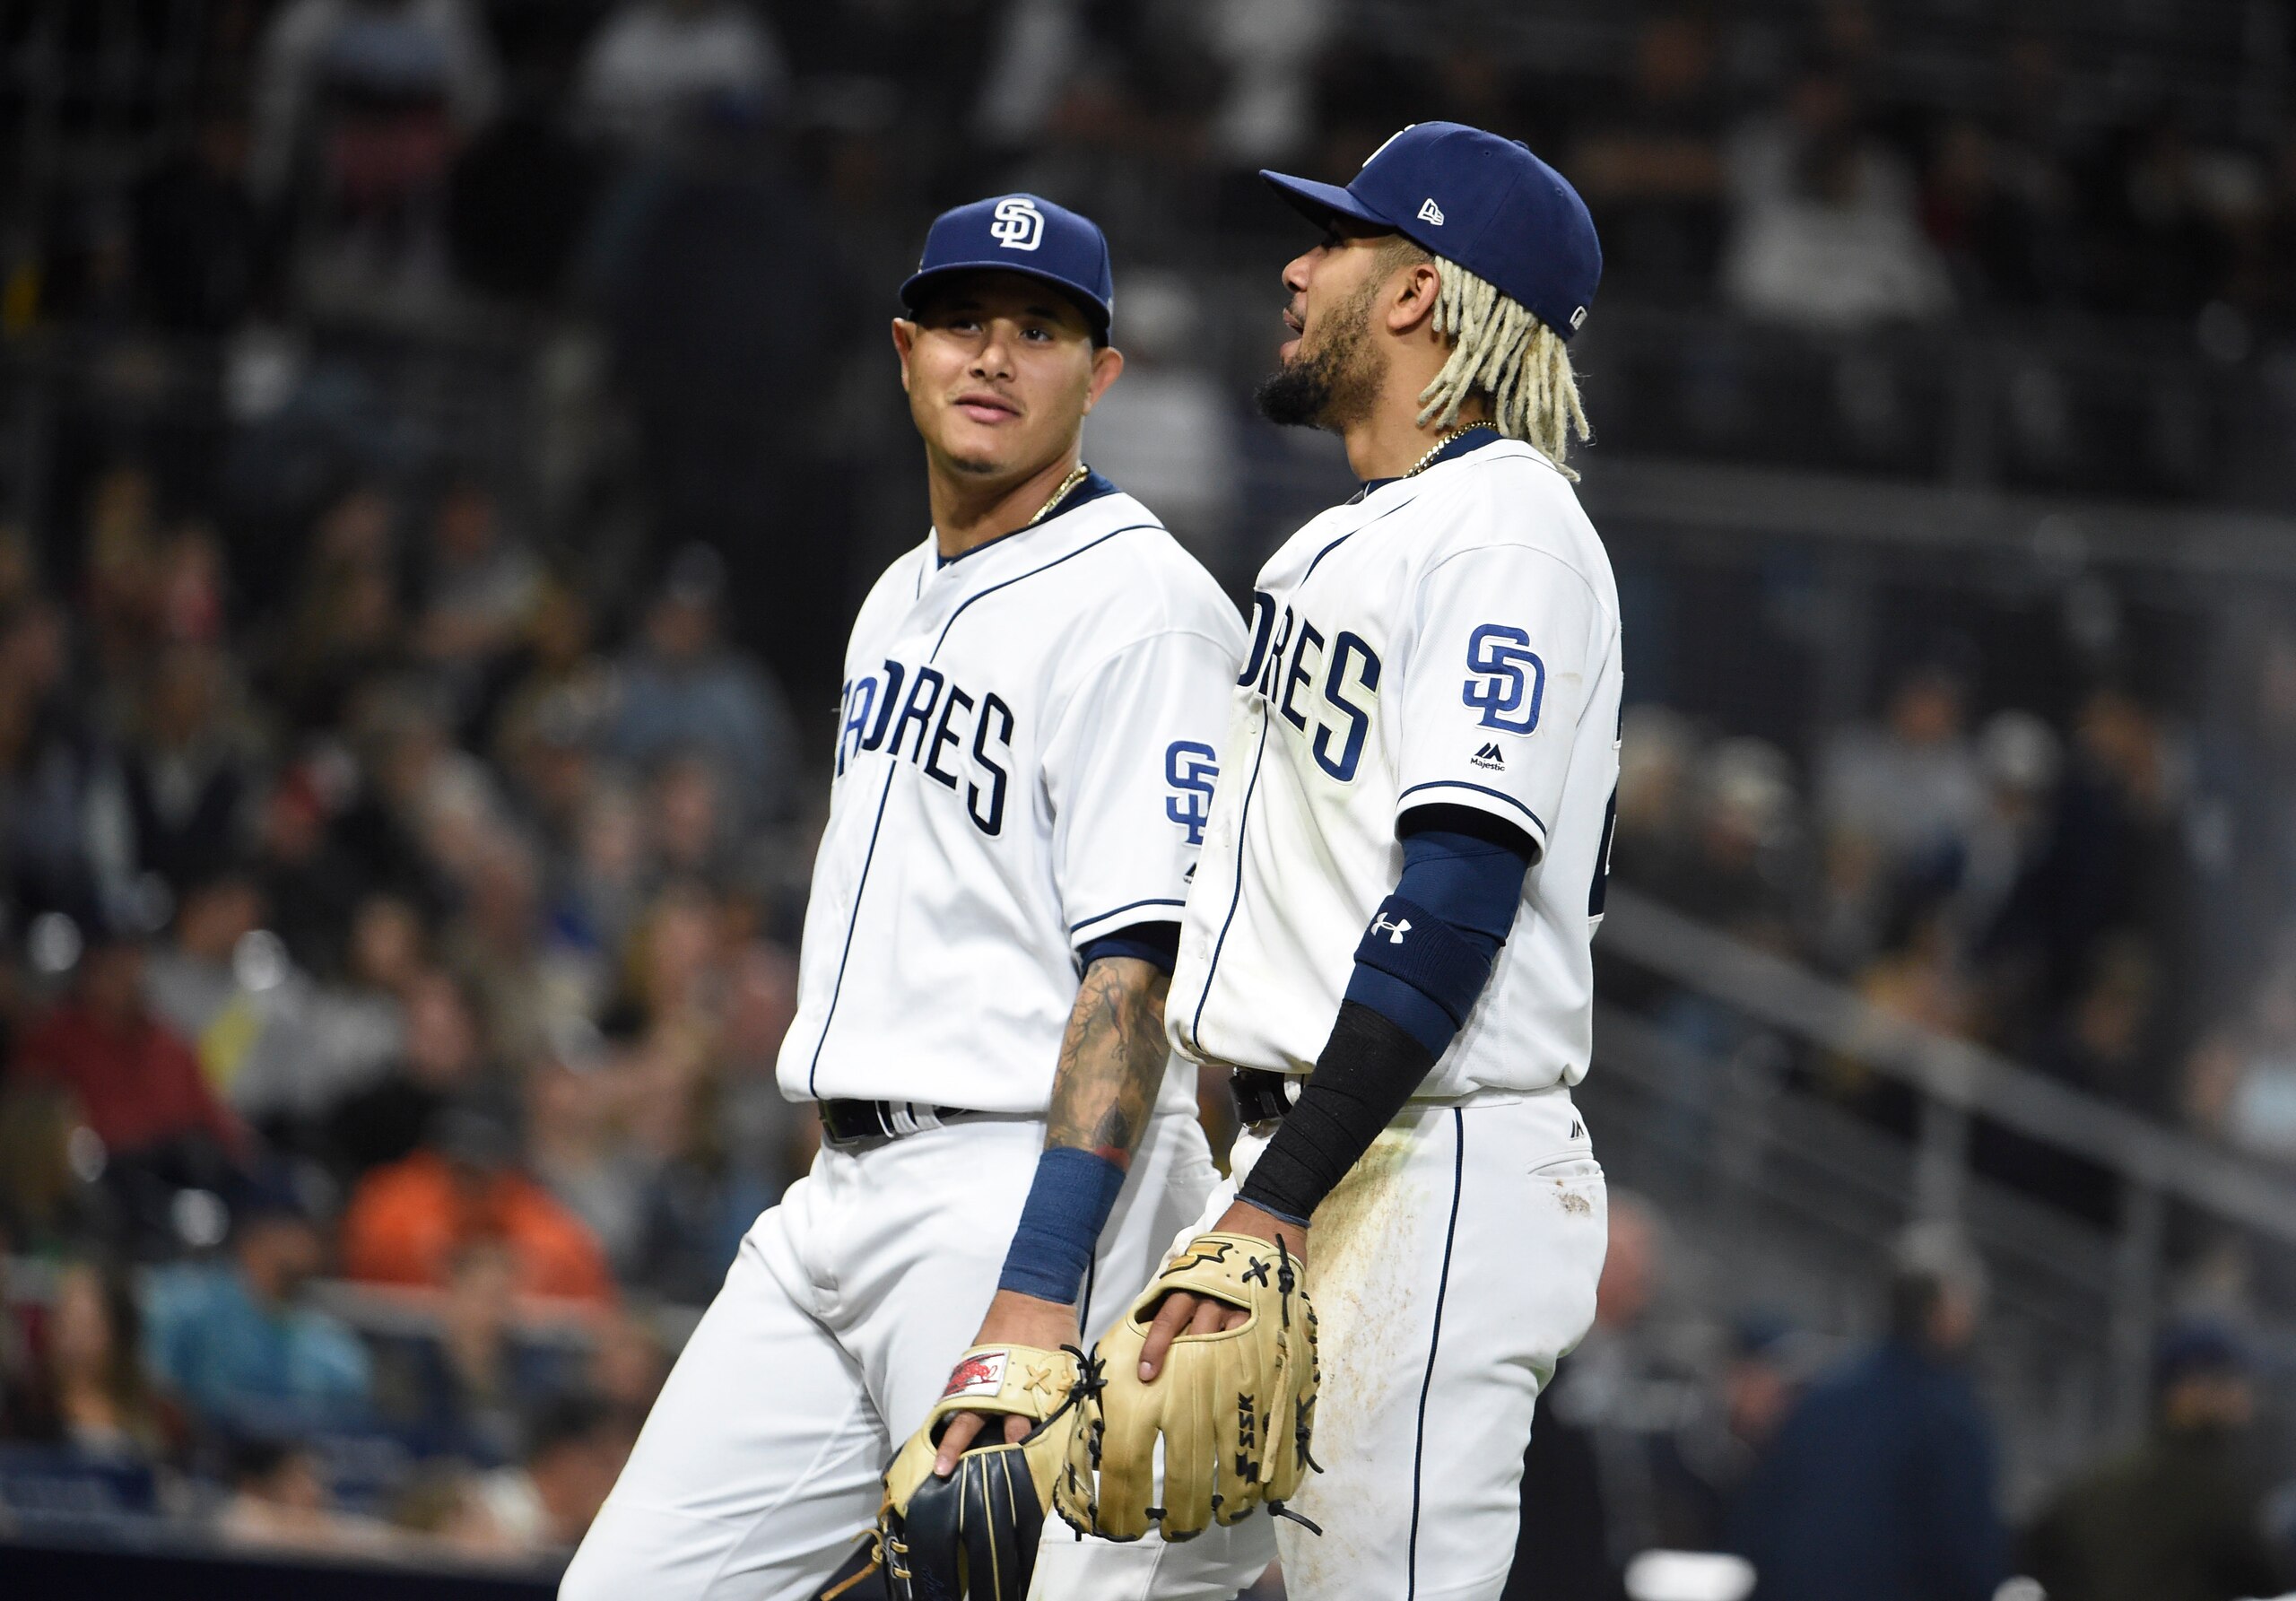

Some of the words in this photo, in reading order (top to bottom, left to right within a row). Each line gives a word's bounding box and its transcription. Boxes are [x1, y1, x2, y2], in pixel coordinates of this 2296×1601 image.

[991, 198, 1045, 251] SD
[1463, 623, 1544, 735] SD
[837, 659, 1014, 836] ADRES
[1470, 757, 1506, 771] Majestic
